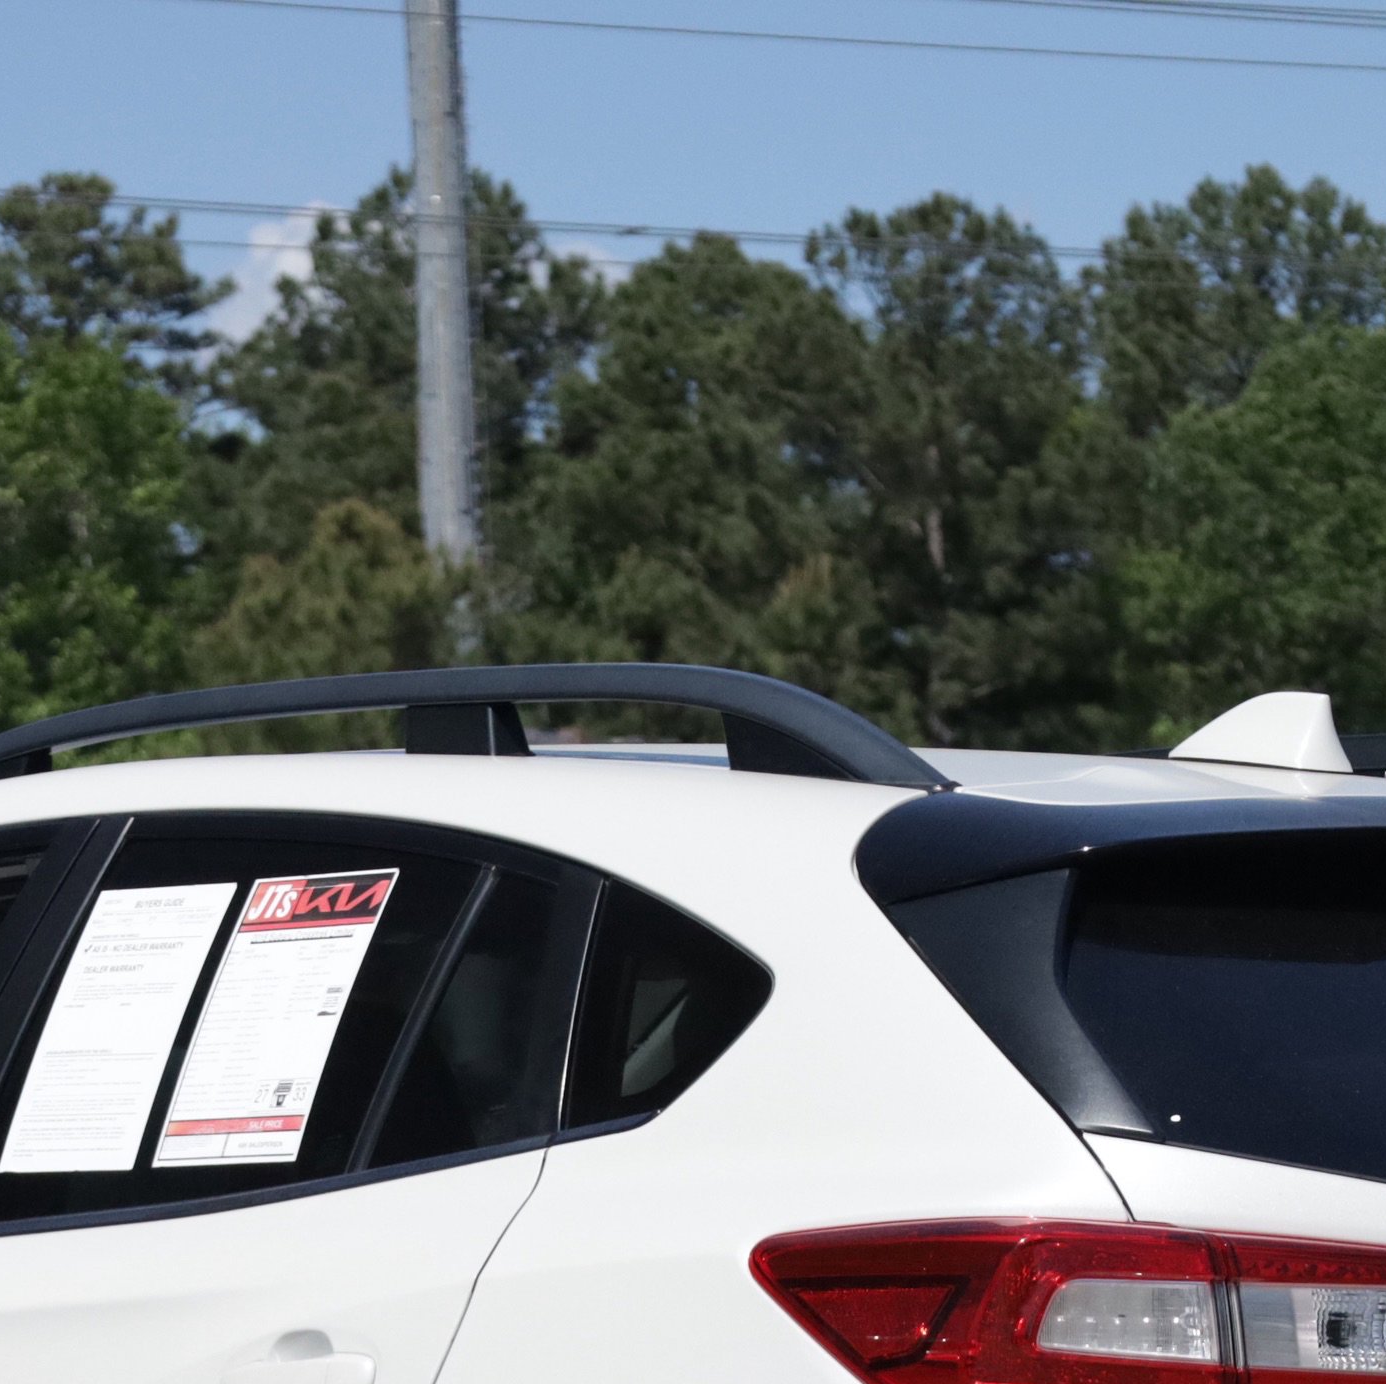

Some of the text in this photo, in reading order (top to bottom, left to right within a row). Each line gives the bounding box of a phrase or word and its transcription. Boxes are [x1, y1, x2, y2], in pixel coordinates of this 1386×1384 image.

[123, 942, 148, 951] DEALER
[149, 941, 184, 950] WARRANTY
[83, 963, 144, 974] DEALER WARRANTY
[254, 1088, 269, 1103] 27
